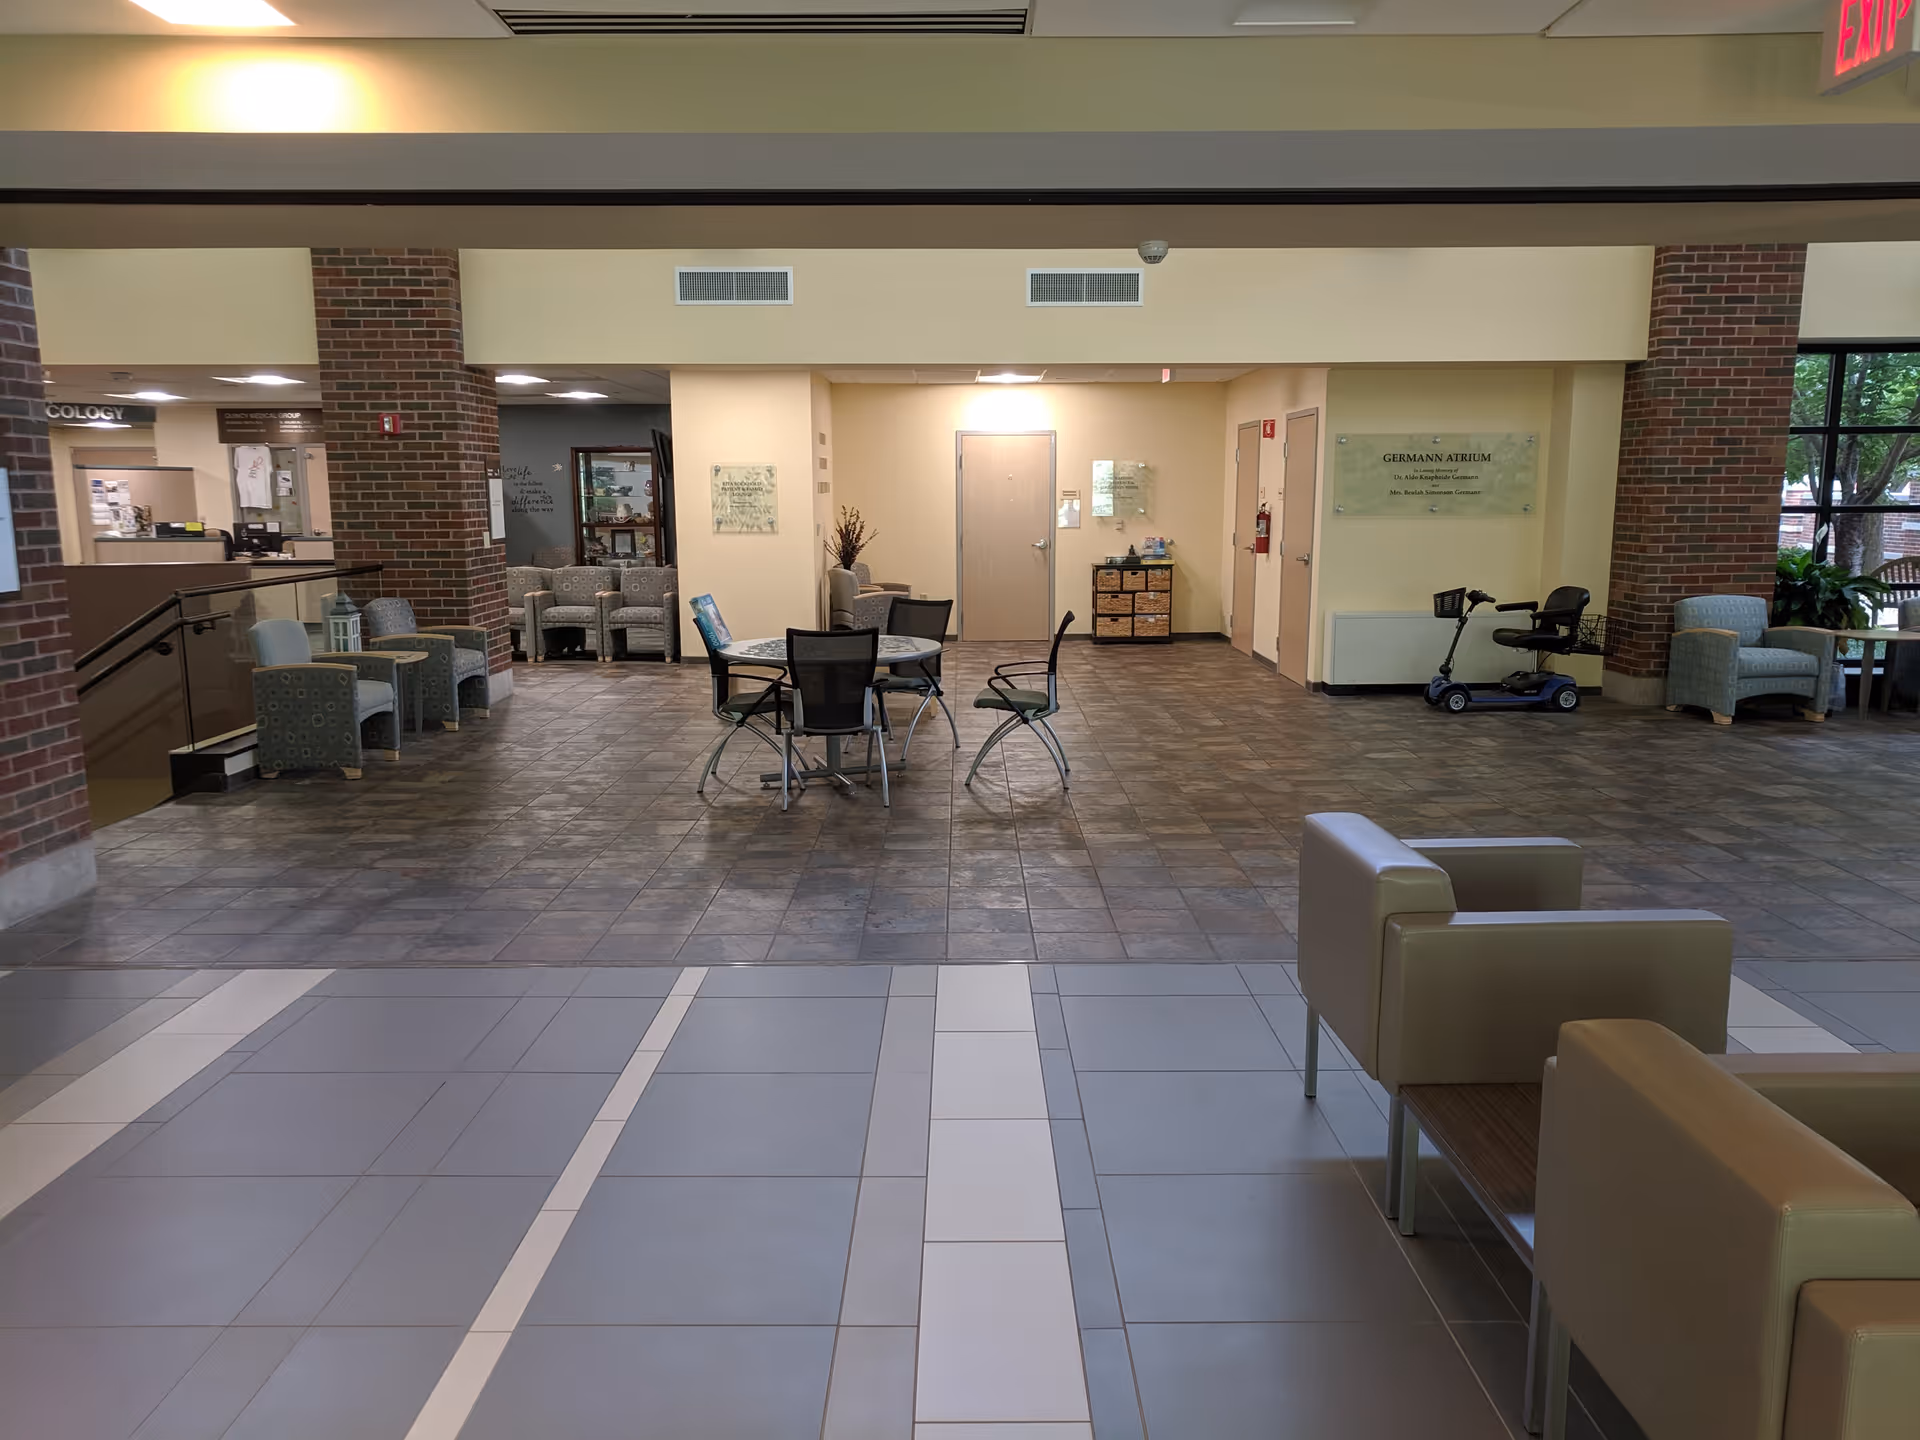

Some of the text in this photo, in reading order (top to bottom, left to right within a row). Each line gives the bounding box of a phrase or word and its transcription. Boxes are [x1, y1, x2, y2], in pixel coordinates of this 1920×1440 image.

[1383, 453, 1491, 463] GERMANN ATRIUM
[529, 505, 540, 513] the
